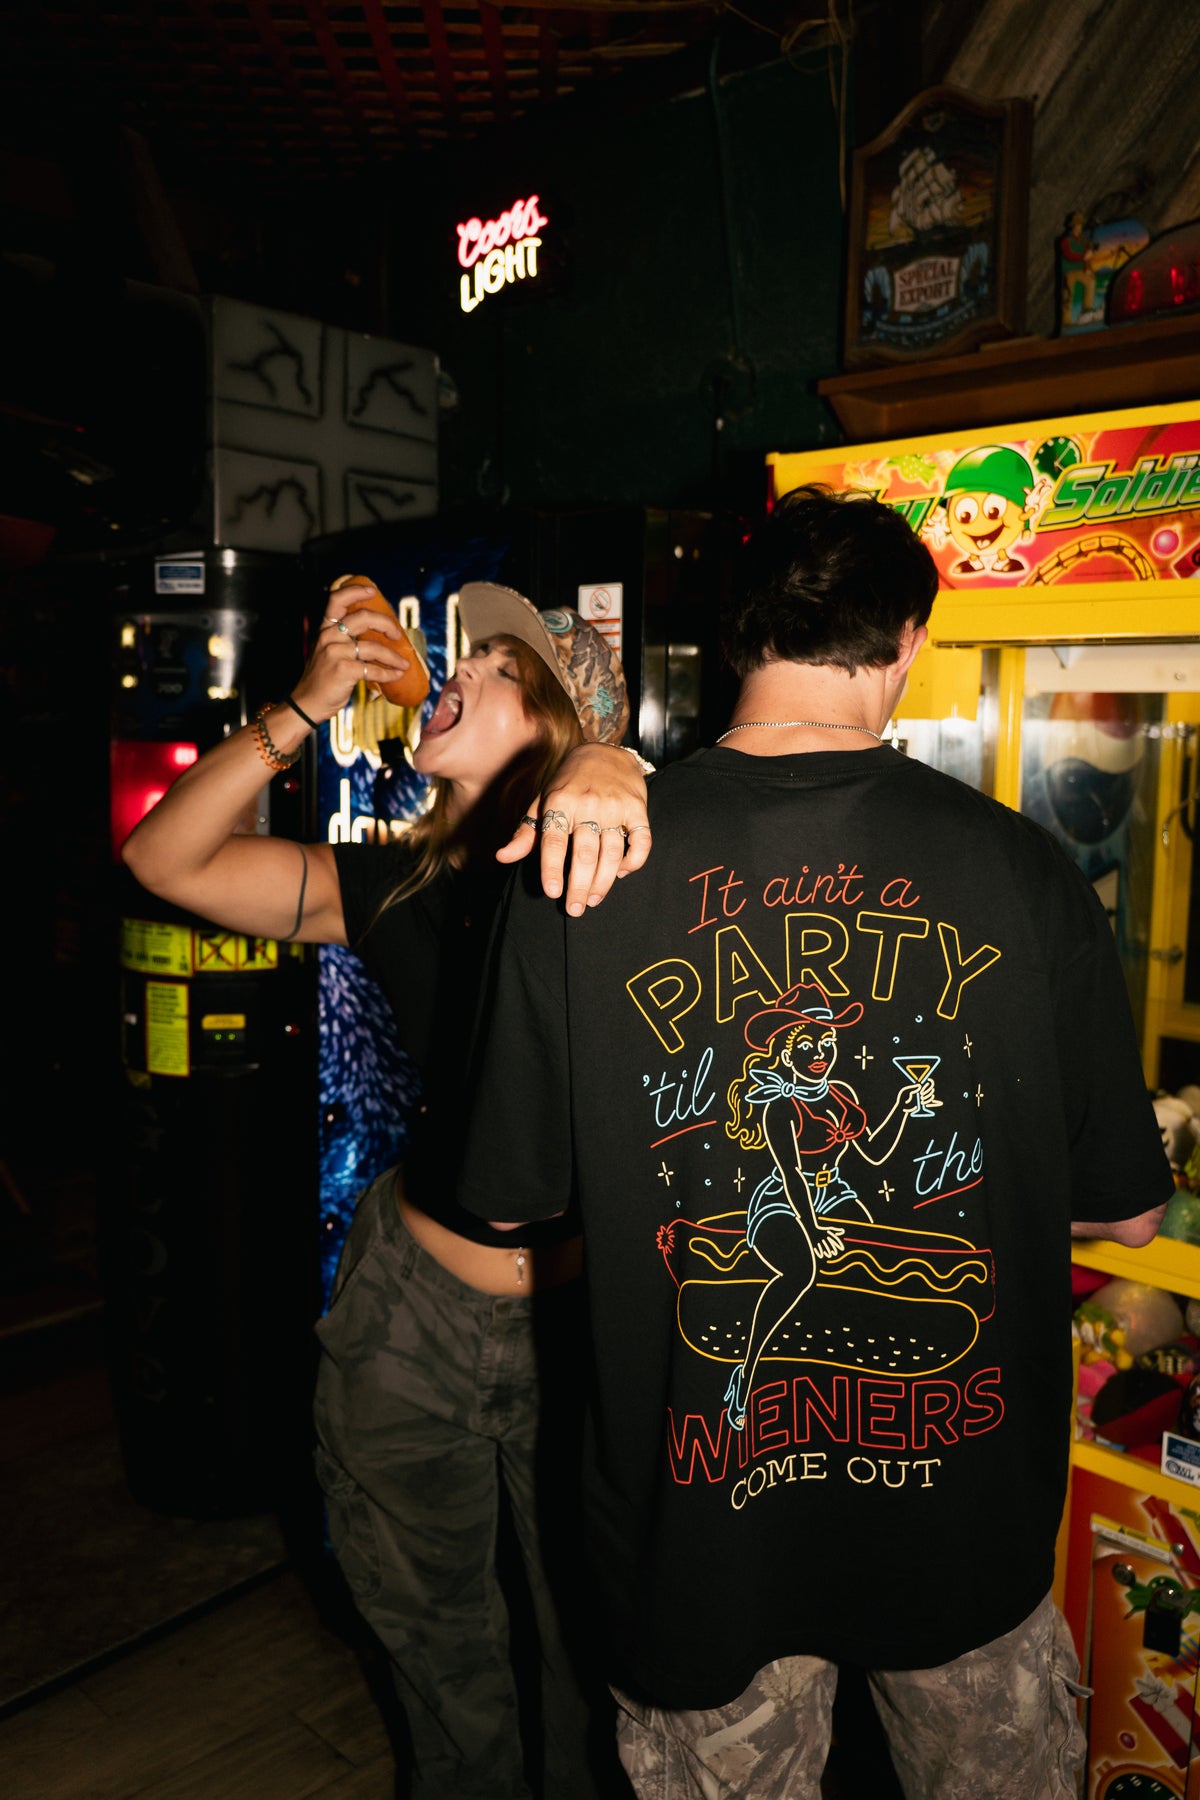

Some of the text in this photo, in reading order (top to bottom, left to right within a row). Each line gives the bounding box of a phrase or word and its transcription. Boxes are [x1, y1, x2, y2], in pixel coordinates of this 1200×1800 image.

[456, 194, 548, 267] Coors
[460, 236, 542, 312] LIGHT
[899, 261, 953, 287] SPECIAL
[899, 280, 953, 307] EXPORT
[688, 863, 921, 934] It ain't a
[626, 911, 1001, 1054] PARTY
[642, 1047, 716, 1127] 'til
[912, 1131, 984, 1196] the
[667, 1367, 1005, 1485] WIENERS
[730, 1452, 941, 1510] COME OUT
